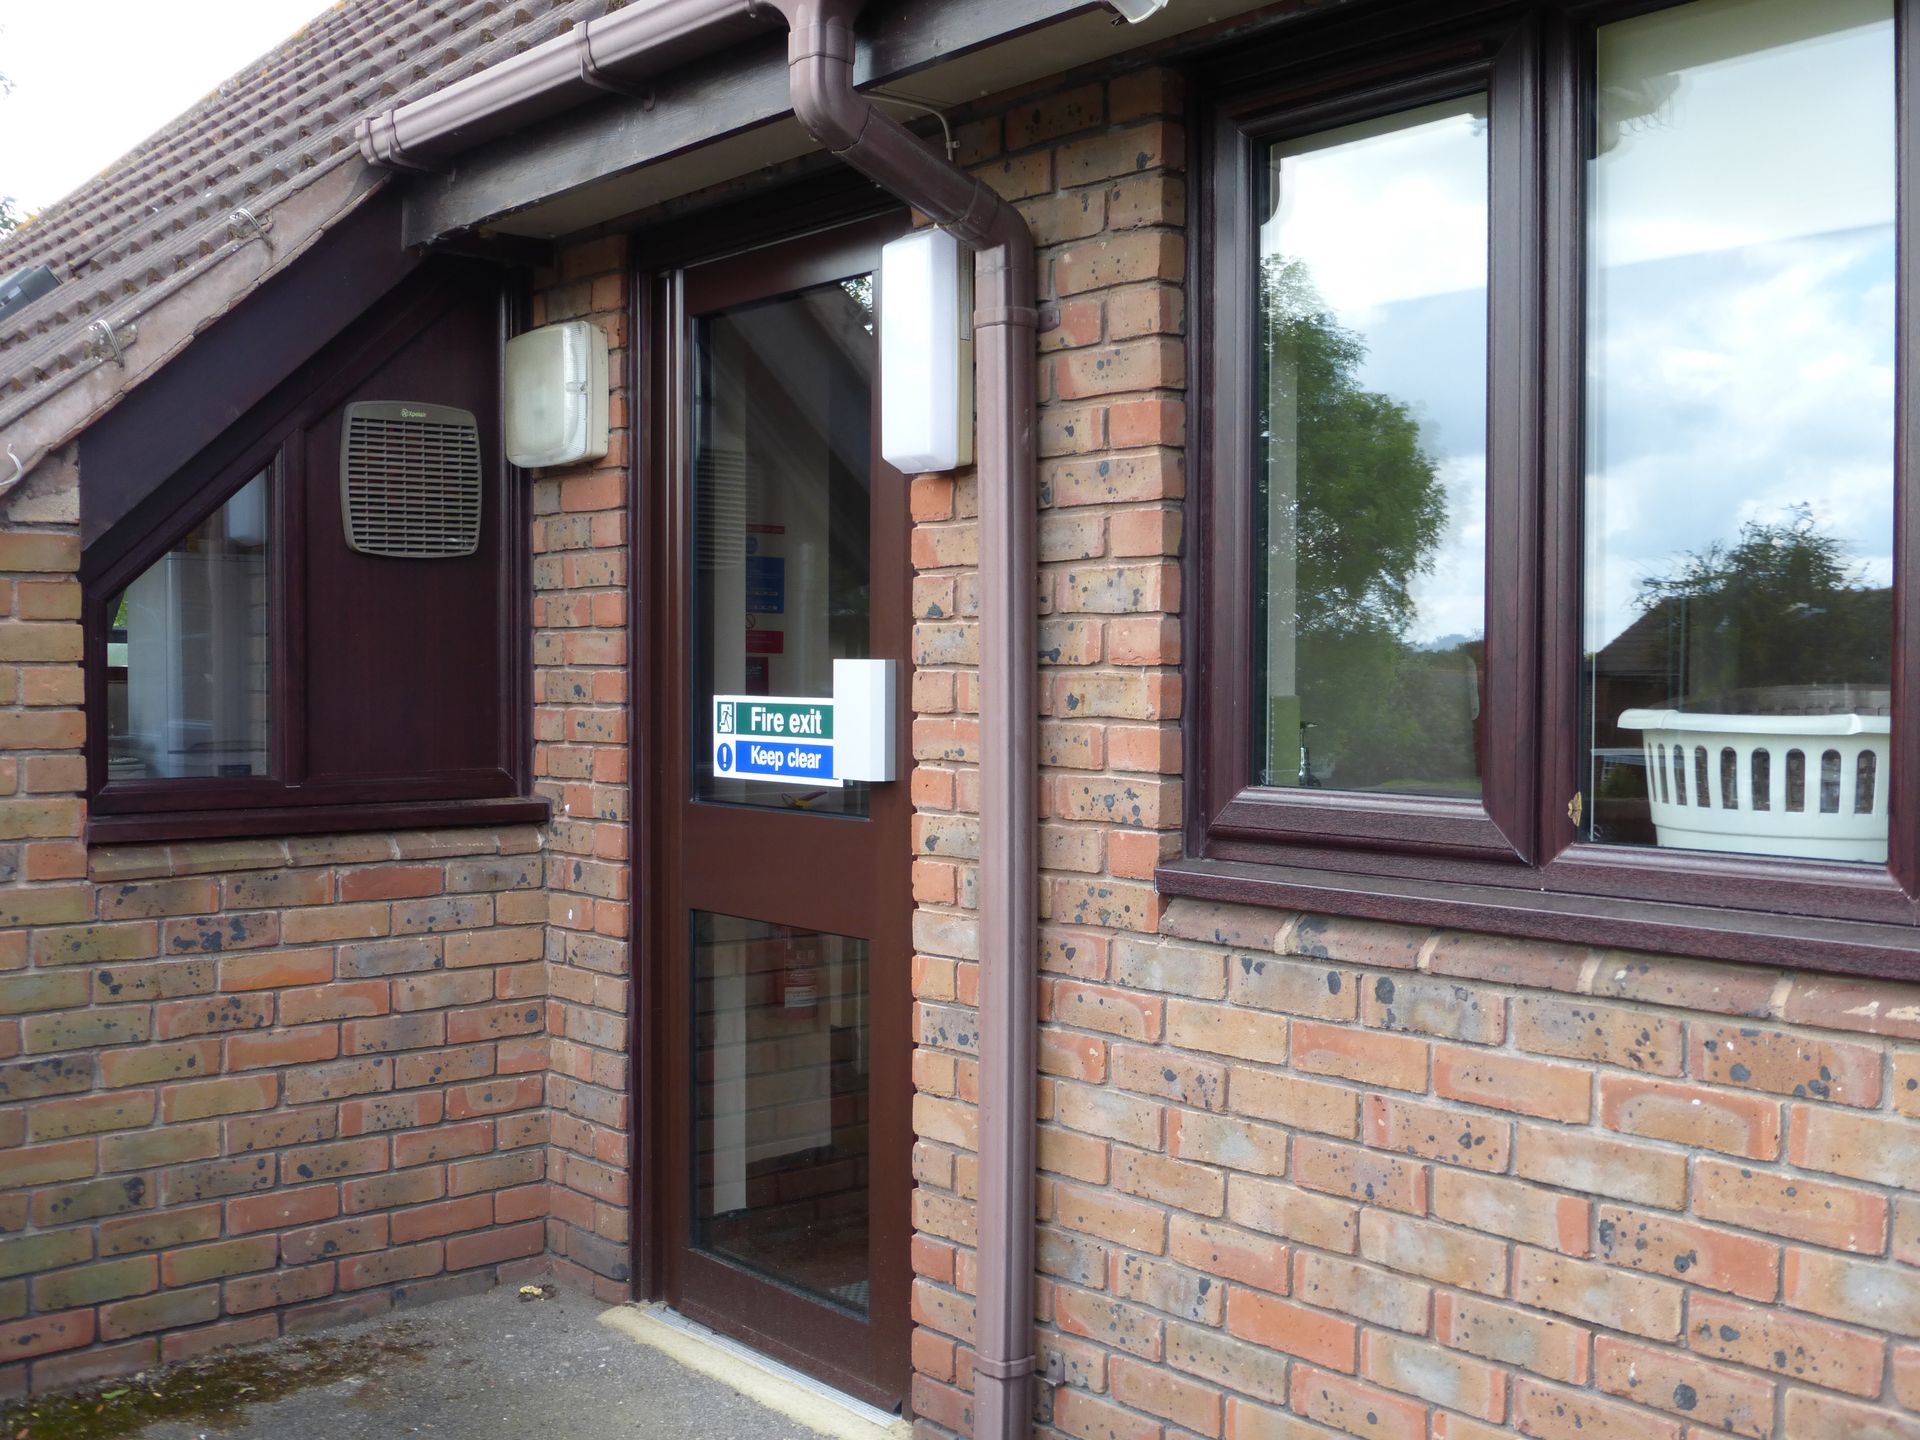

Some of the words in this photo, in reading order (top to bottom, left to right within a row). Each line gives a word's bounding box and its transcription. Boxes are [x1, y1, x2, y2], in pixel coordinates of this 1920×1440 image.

[751, 706, 785, 733] Fire
[788, 708, 822, 735] exit
[751, 744, 785, 772] Keep
[786, 747, 822, 769] clear
